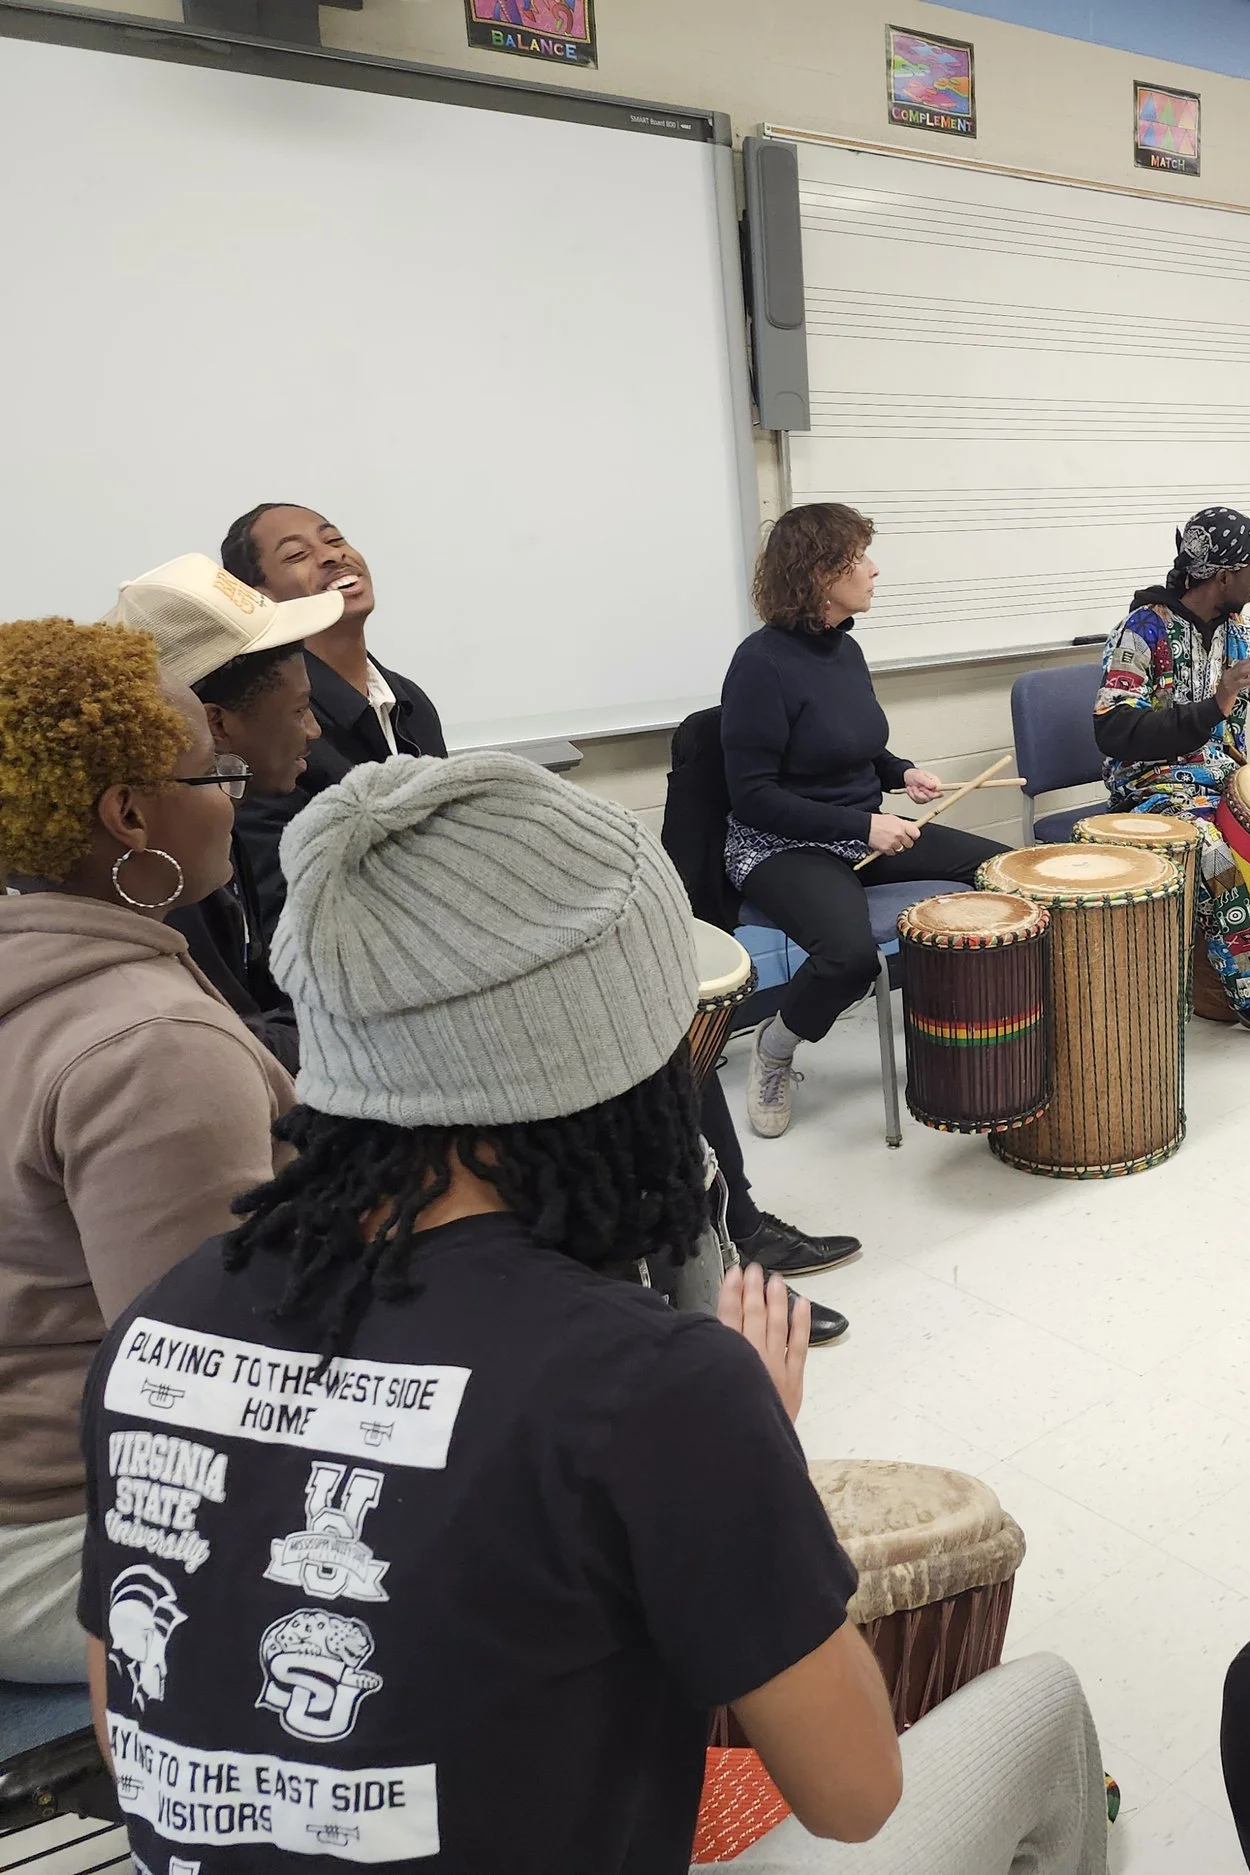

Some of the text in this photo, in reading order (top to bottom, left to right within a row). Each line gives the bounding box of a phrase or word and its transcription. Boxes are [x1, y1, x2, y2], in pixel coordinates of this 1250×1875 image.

[491, 29, 578, 60] BALANCE
[630, 114, 649, 125] SMART
[891, 106, 973, 133] COMPLEMENT
[1150, 154, 1186, 171] MATCH
[127, 1331, 440, 1411] PLAYING TO THE WEST SIDE
[240, 1397, 318, 1436] HOME
[108, 1430, 229, 1503] VIRGINIA
[115, 1476, 202, 1531] STATE
[104, 1507, 211, 1574] University
[159, 1751, 180, 1788] TO
[188, 1761, 242, 1794] THE
[255, 1766, 319, 1809] EAST
[331, 1780, 406, 1813] SIDE
[158, 1791, 273, 1834] VISITORS
